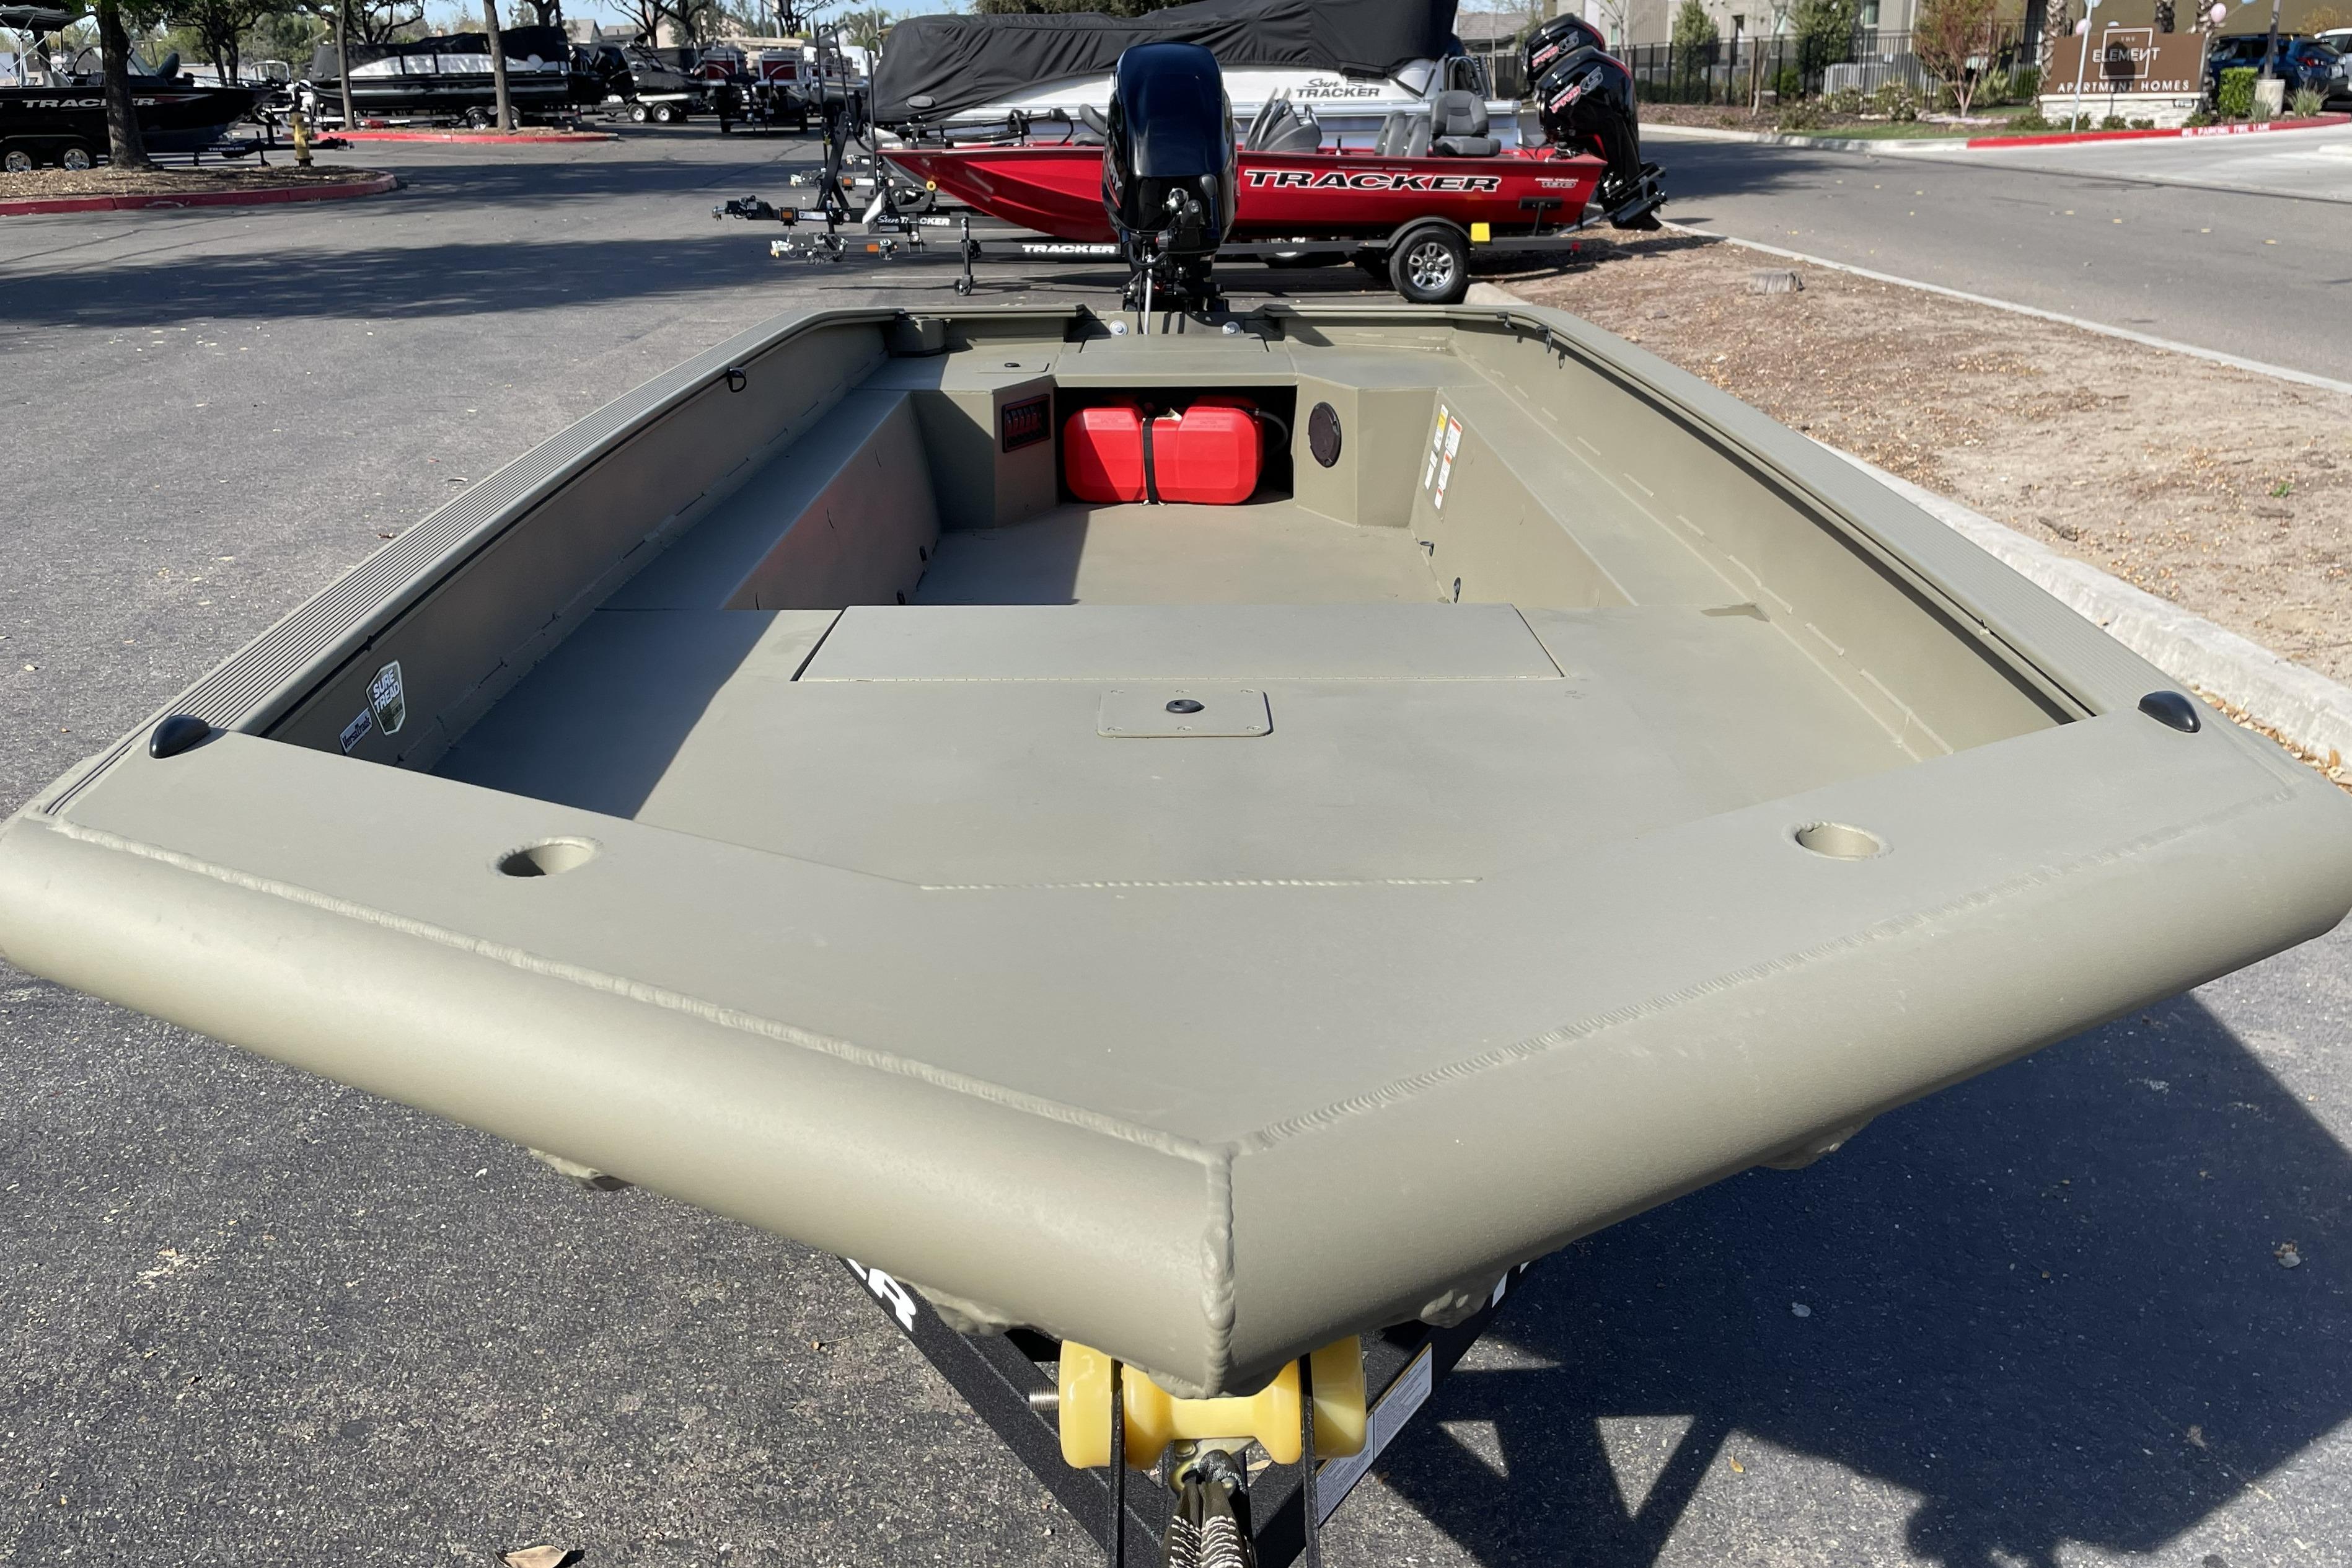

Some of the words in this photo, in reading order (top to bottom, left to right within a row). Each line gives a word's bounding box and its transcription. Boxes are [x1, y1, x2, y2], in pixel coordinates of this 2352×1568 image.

[2092, 47, 2160, 63] ELEMENT
[1304, 78, 1339, 87] Sun
[2141, 79, 2190, 92] HOMES
[1297, 88, 1380, 97] TRACKER
[22, 98, 155, 108] TRACR
[1244, 169, 1502, 192] TRACKER
[878, 215, 899, 223] Sun
[1022, 245, 1116, 253] TRACKER
[373, 669, 395, 698] SURE
[374, 681, 400, 713] TREAD
